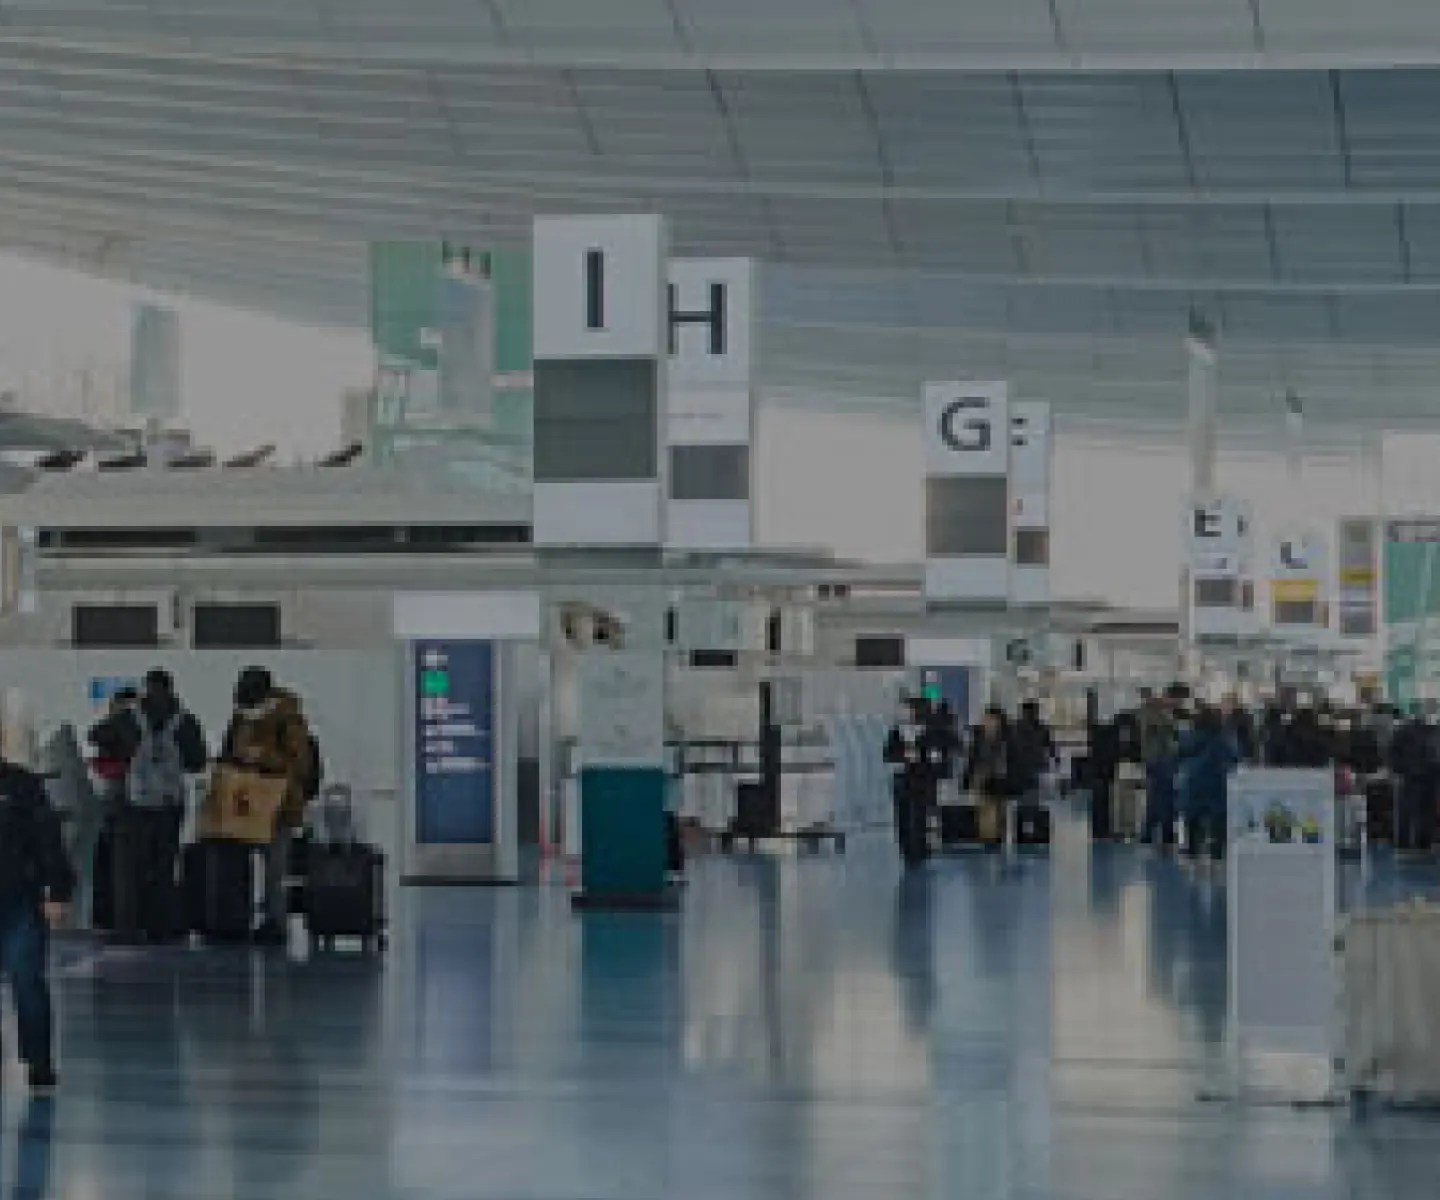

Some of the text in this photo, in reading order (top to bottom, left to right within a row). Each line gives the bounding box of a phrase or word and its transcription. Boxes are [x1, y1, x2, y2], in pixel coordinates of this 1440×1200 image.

[585, 250, 606, 330] I
[666, 281, 725, 356] H
[938, 397, 992, 452] G
